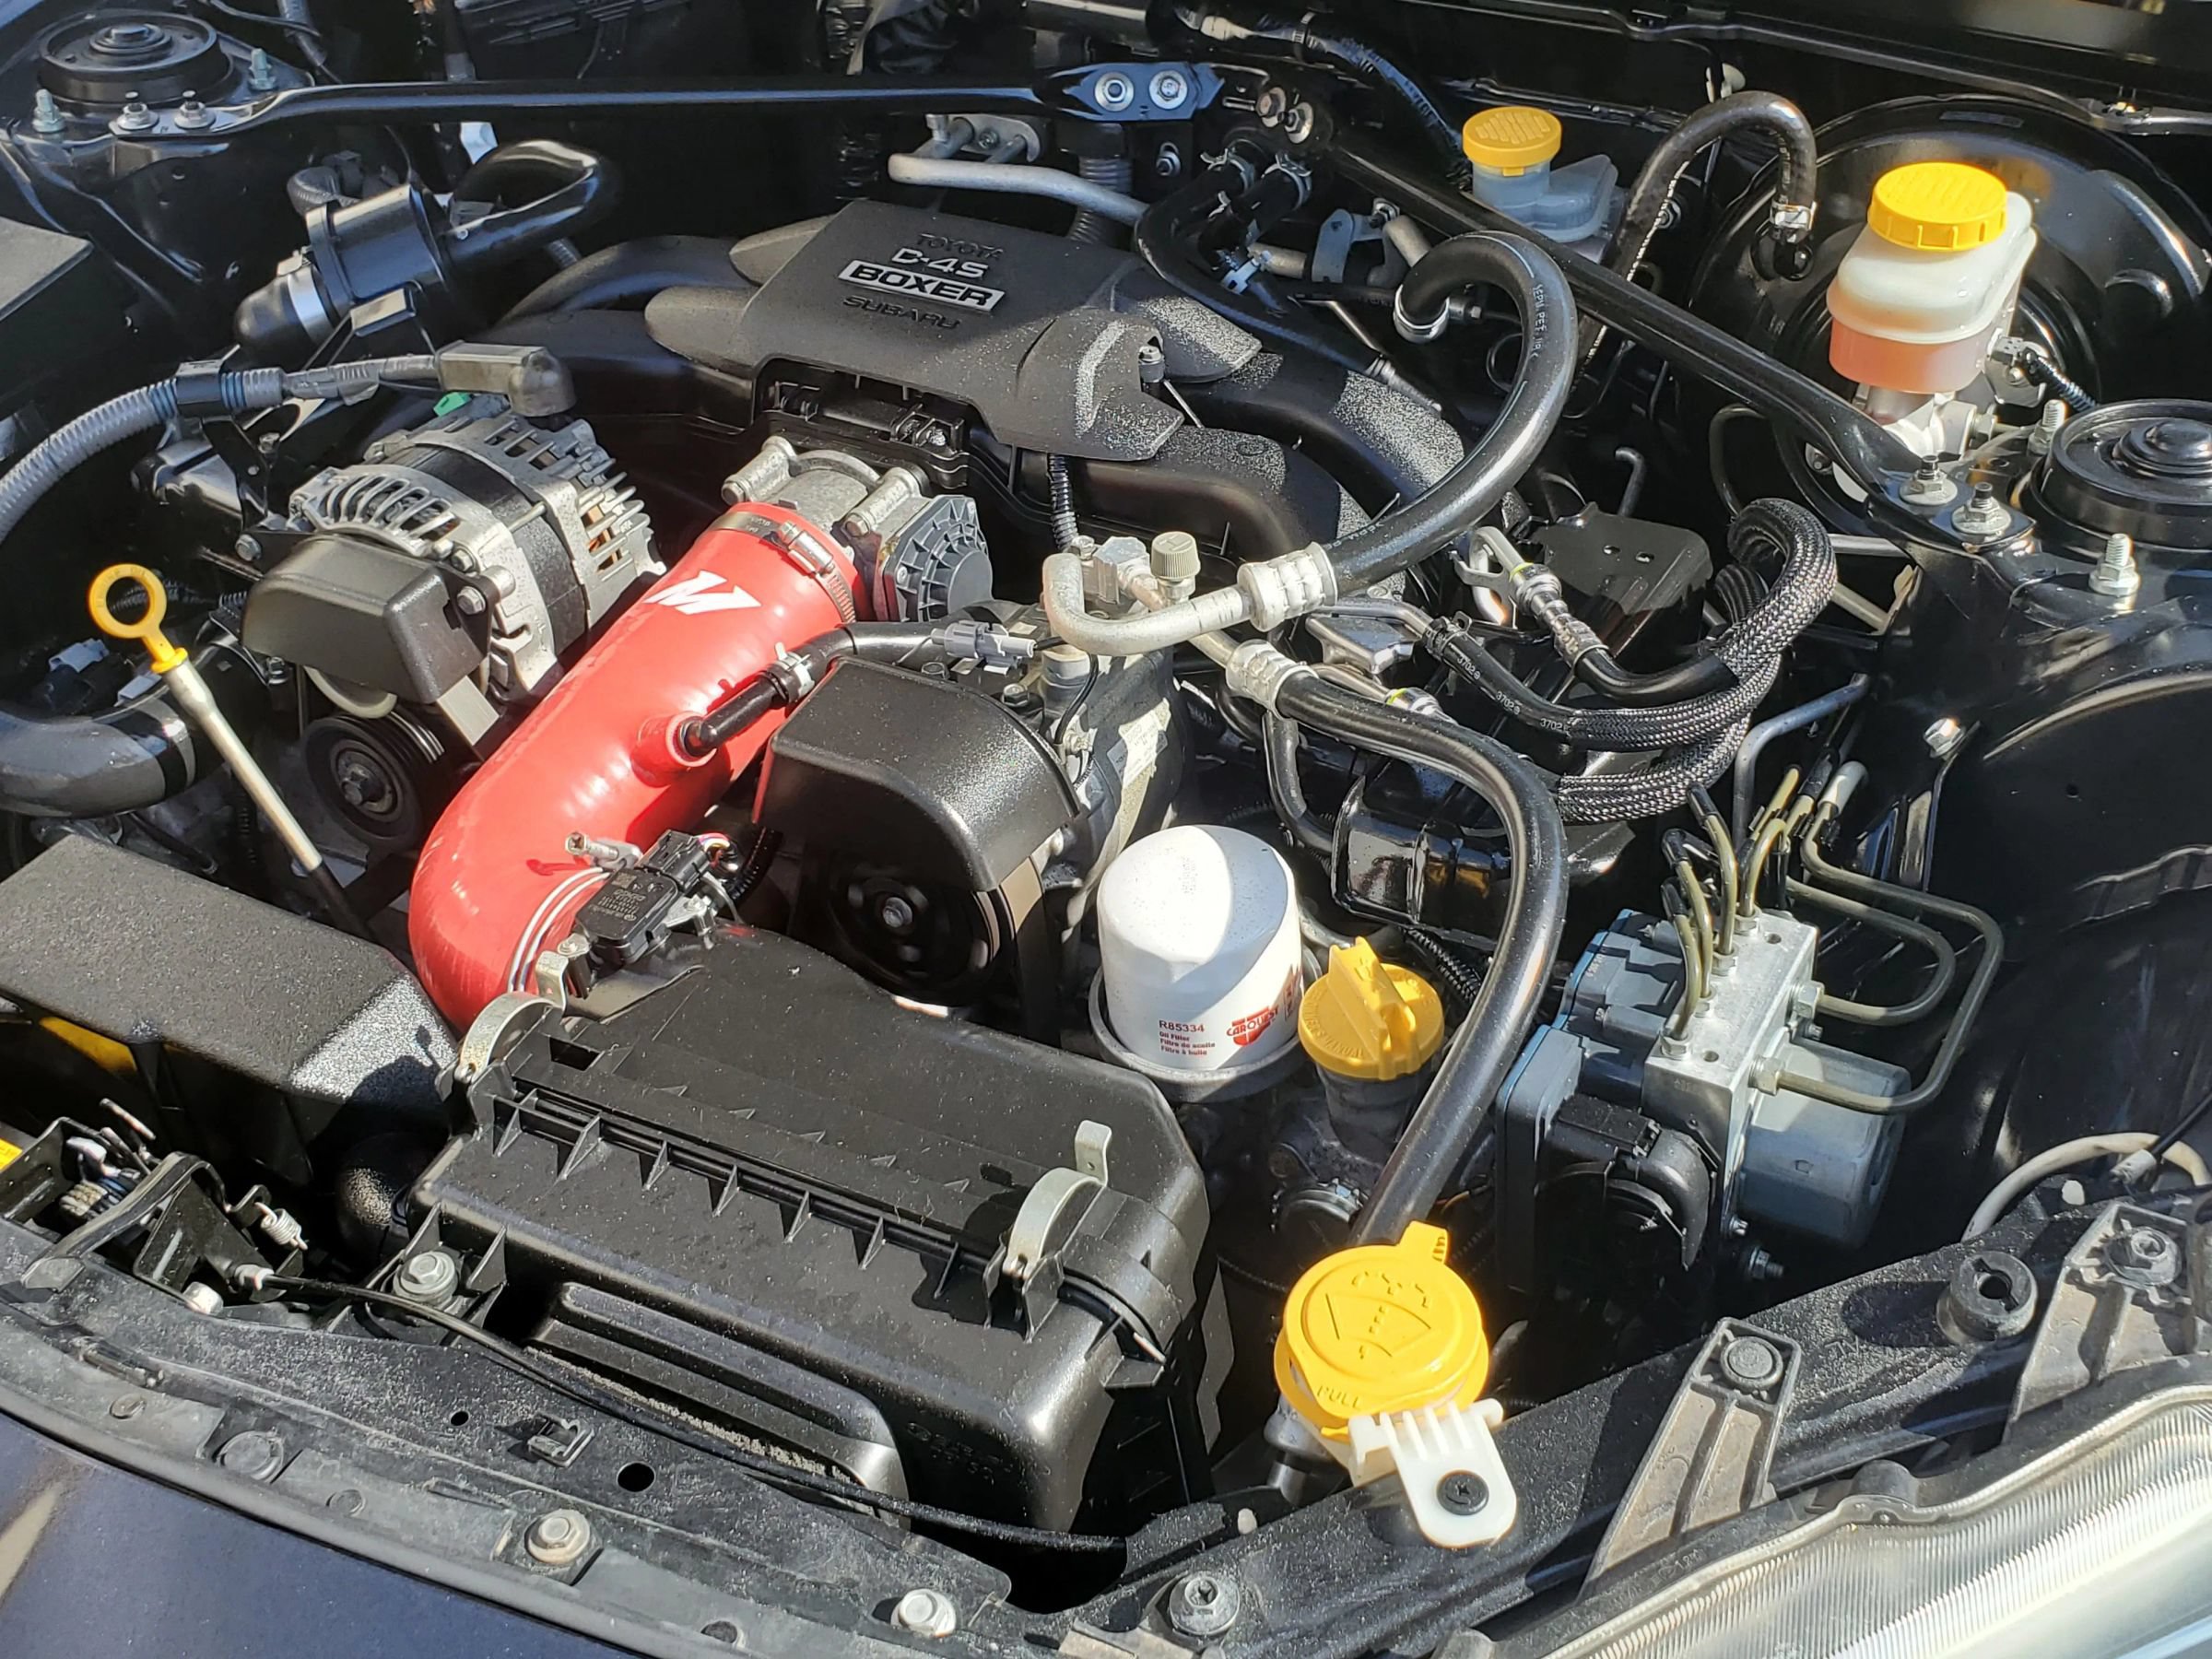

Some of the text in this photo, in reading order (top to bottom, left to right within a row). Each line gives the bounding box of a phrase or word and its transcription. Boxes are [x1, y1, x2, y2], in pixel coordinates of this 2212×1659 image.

[916, 233, 1004, 260] TOYOTA
[891, 247, 989, 278] D-4S
[849, 264, 994, 306] BOXER
[842, 295, 961, 330] SUBARU
[1159, 1019, 1205, 1032] R85334
[1316, 1385, 1362, 1410] PULL
